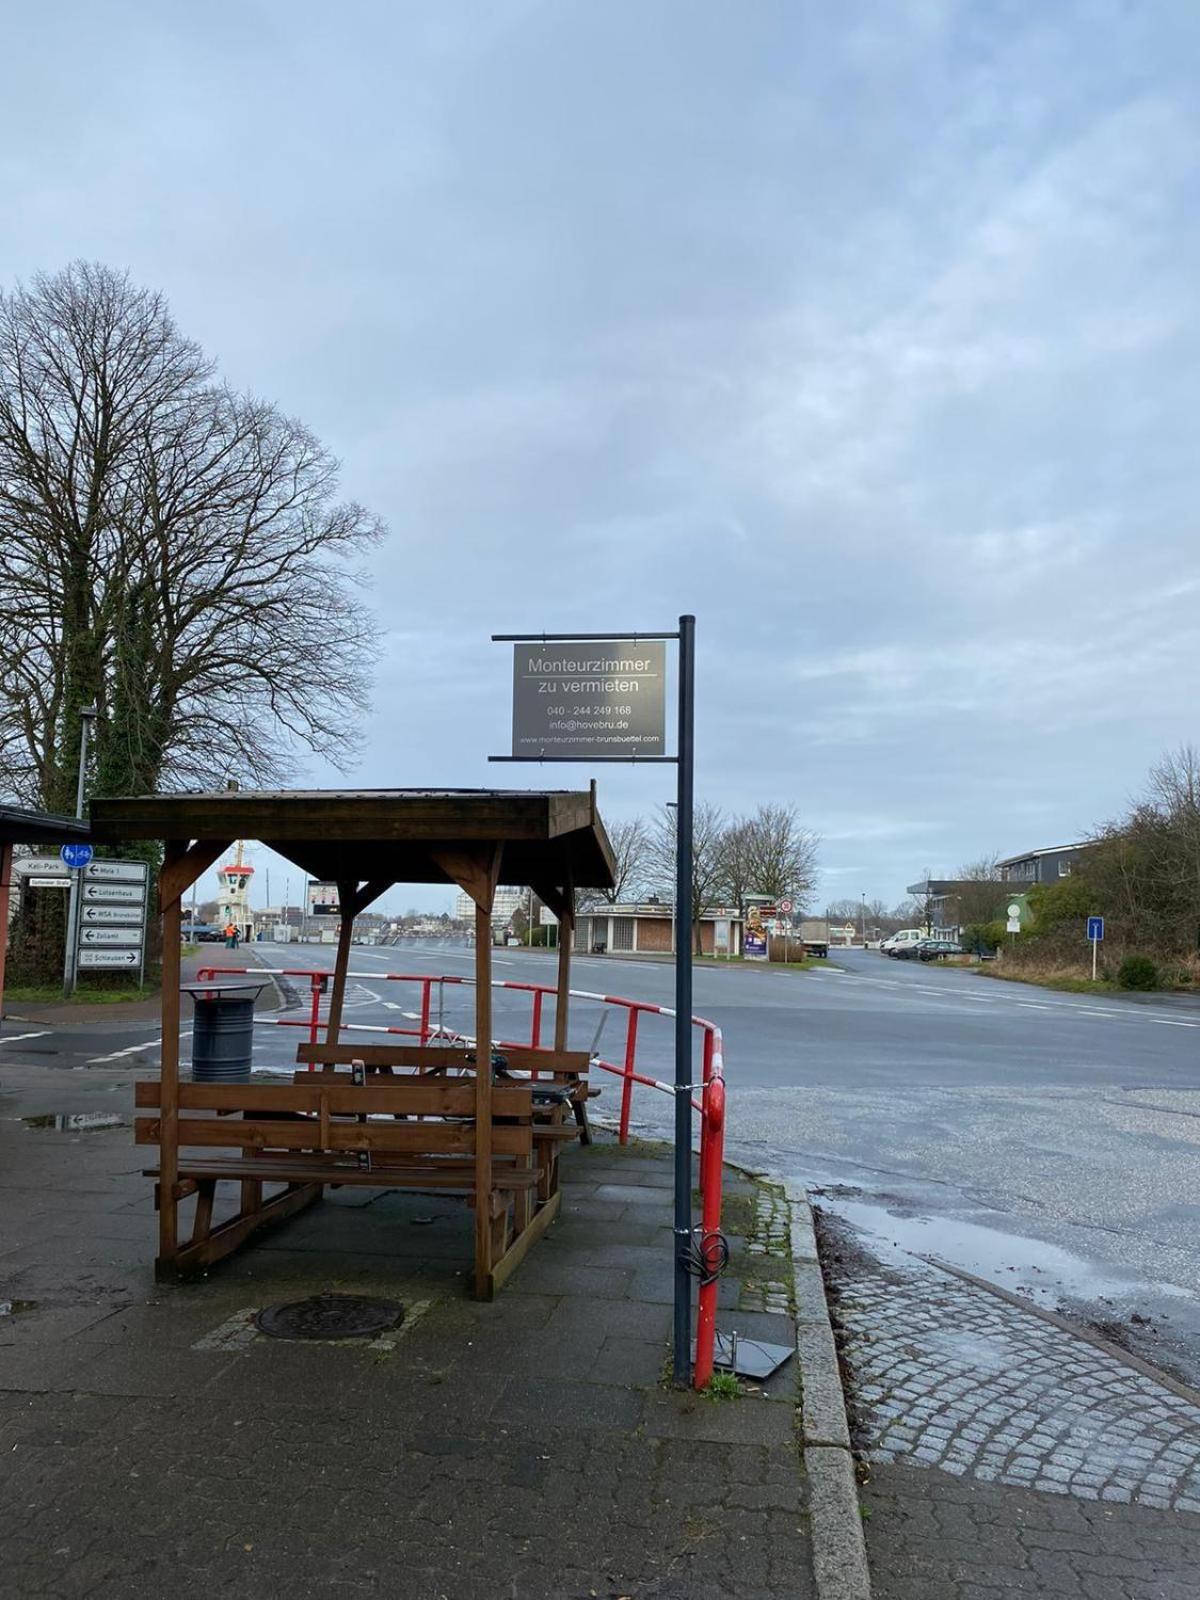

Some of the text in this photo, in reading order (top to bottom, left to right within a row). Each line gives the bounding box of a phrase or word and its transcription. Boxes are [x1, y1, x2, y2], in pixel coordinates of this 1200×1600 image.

[528, 658, 651, 672] Monteurzimmer
[538, 679, 640, 693] zu vermieten
[546, 706, 565, 716] 040
[573, 706, 591, 716] 244
[593, 706, 612, 716] 249
[614, 705, 632, 716] 168
